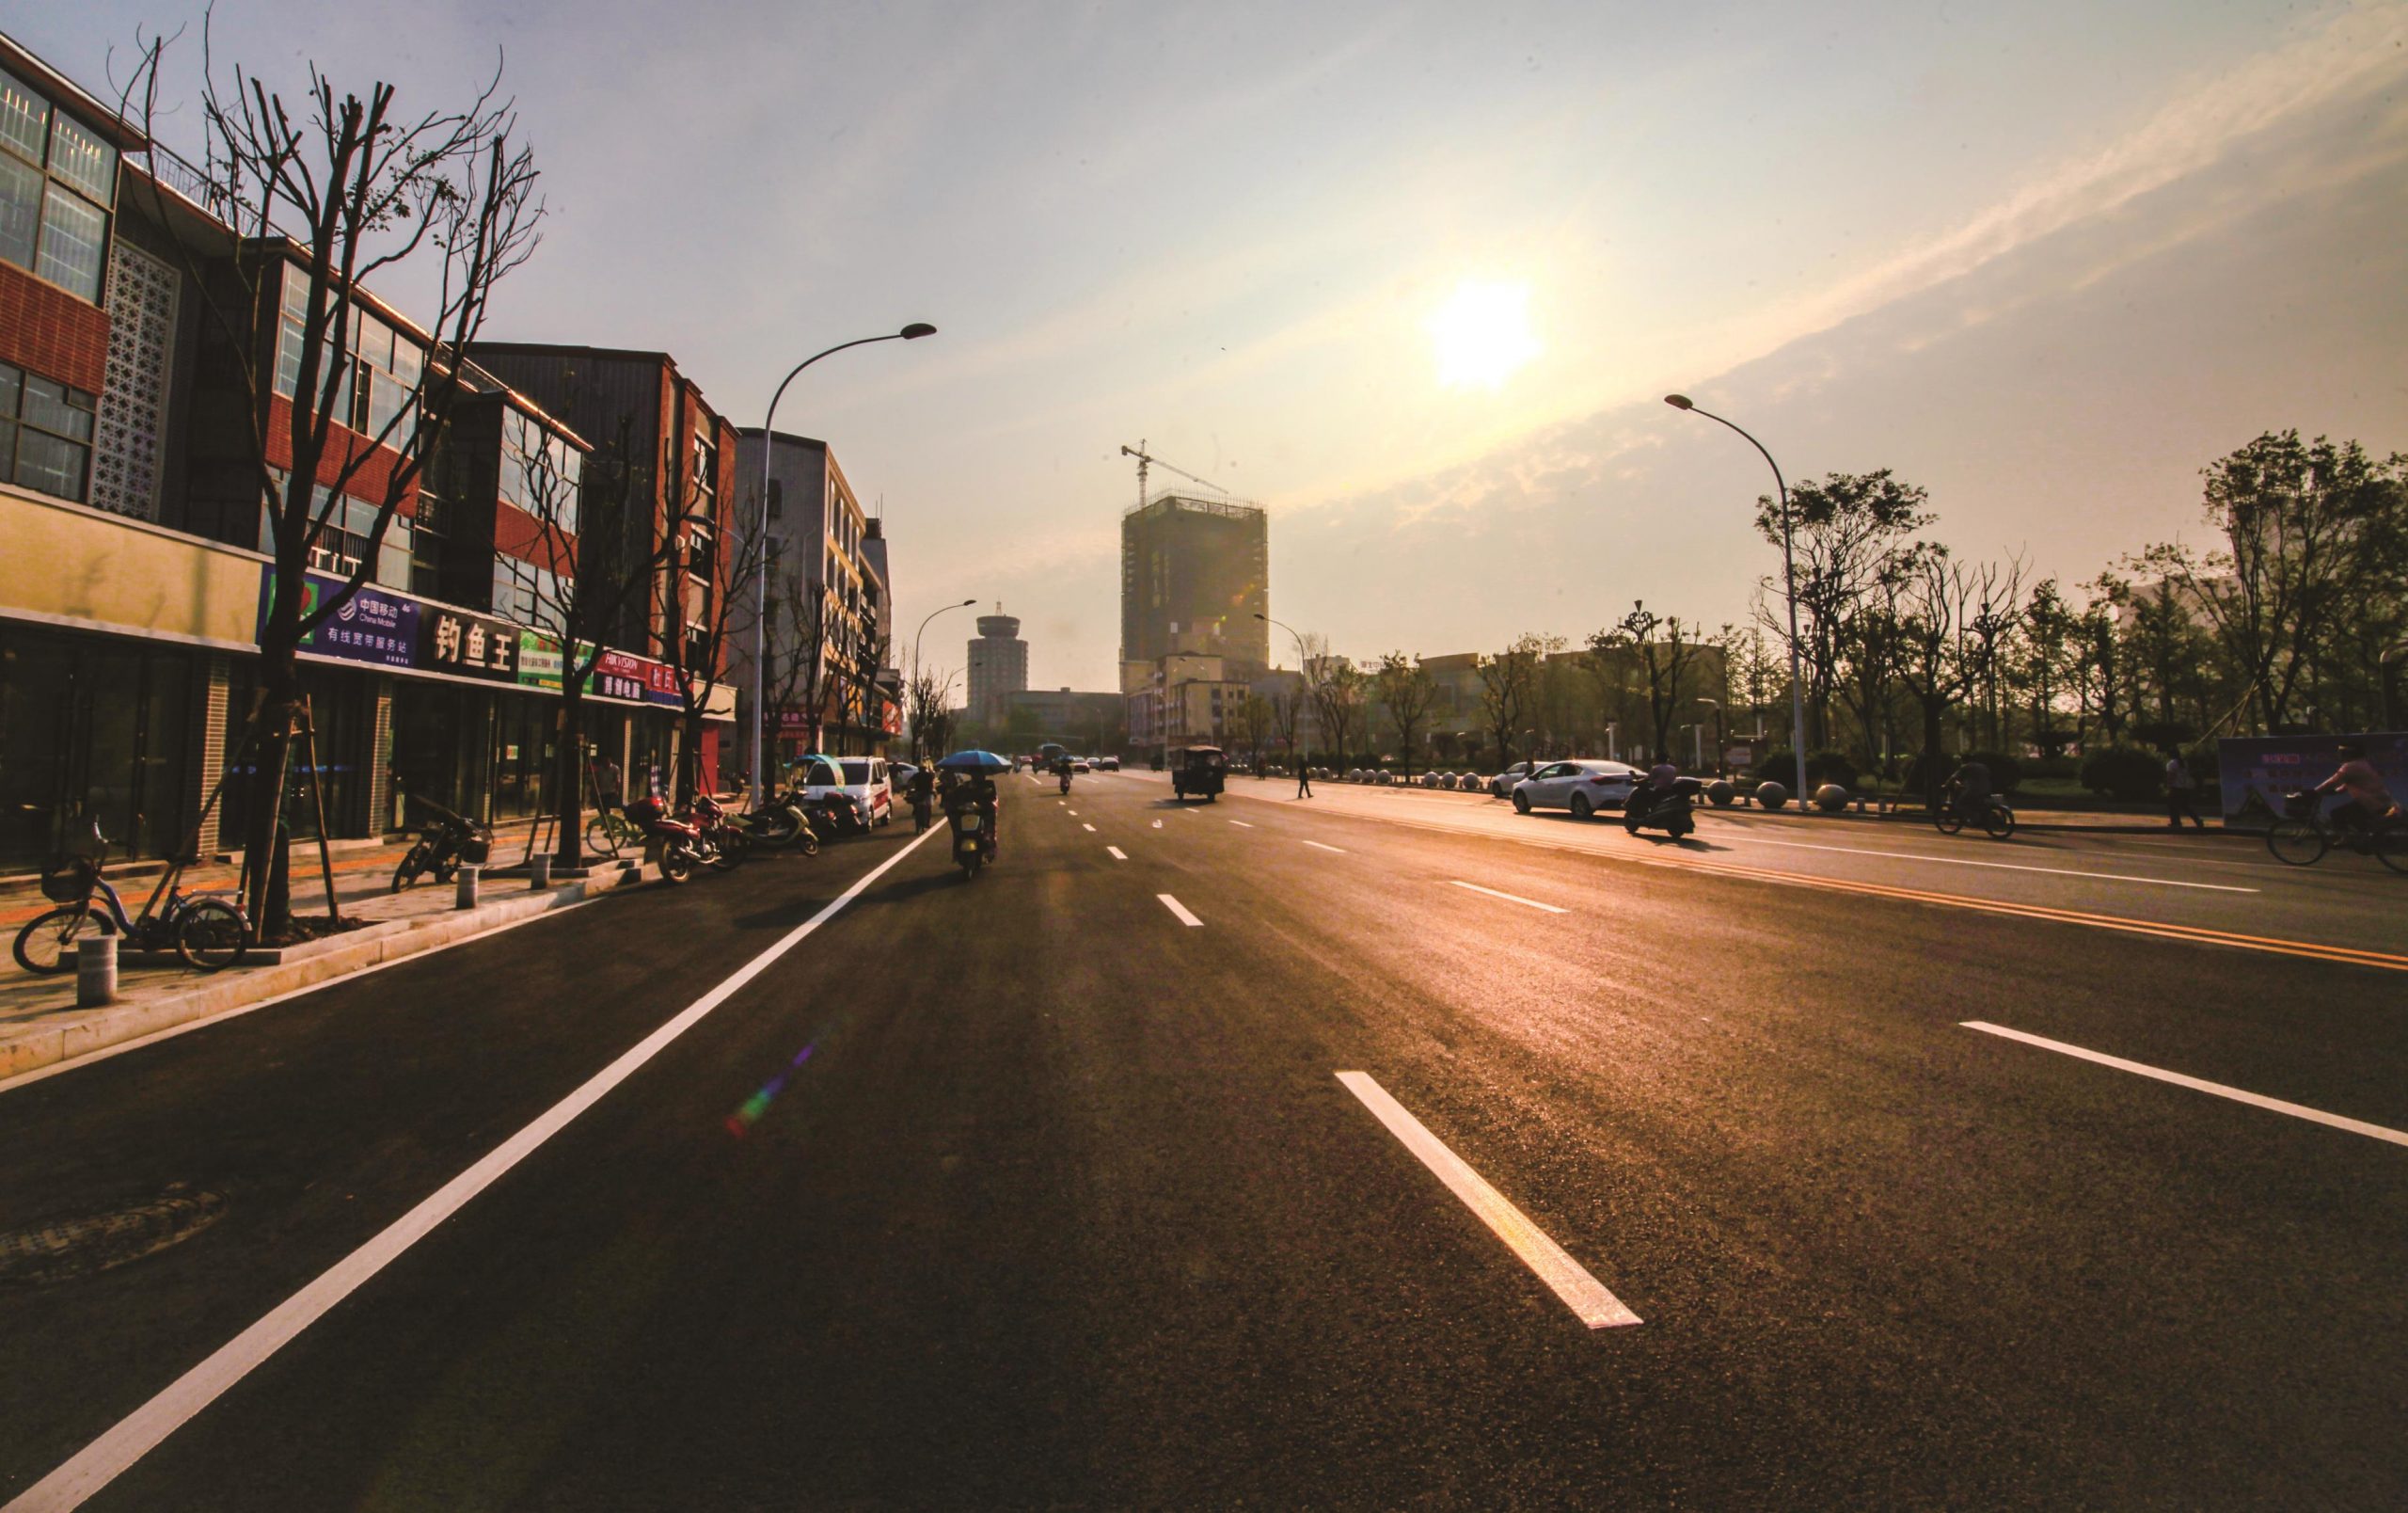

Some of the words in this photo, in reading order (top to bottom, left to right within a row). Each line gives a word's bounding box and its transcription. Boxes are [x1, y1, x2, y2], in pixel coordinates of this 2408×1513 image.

[360, 598, 398, 618] 中国移动
[359, 613, 377, 625] China
[377, 617, 396, 628] Mobile
[328, 628, 407, 653] 有线宽带服务站
[436, 615, 513, 671] 钓鱼王
[606, 653, 639, 670] HIKVISION
